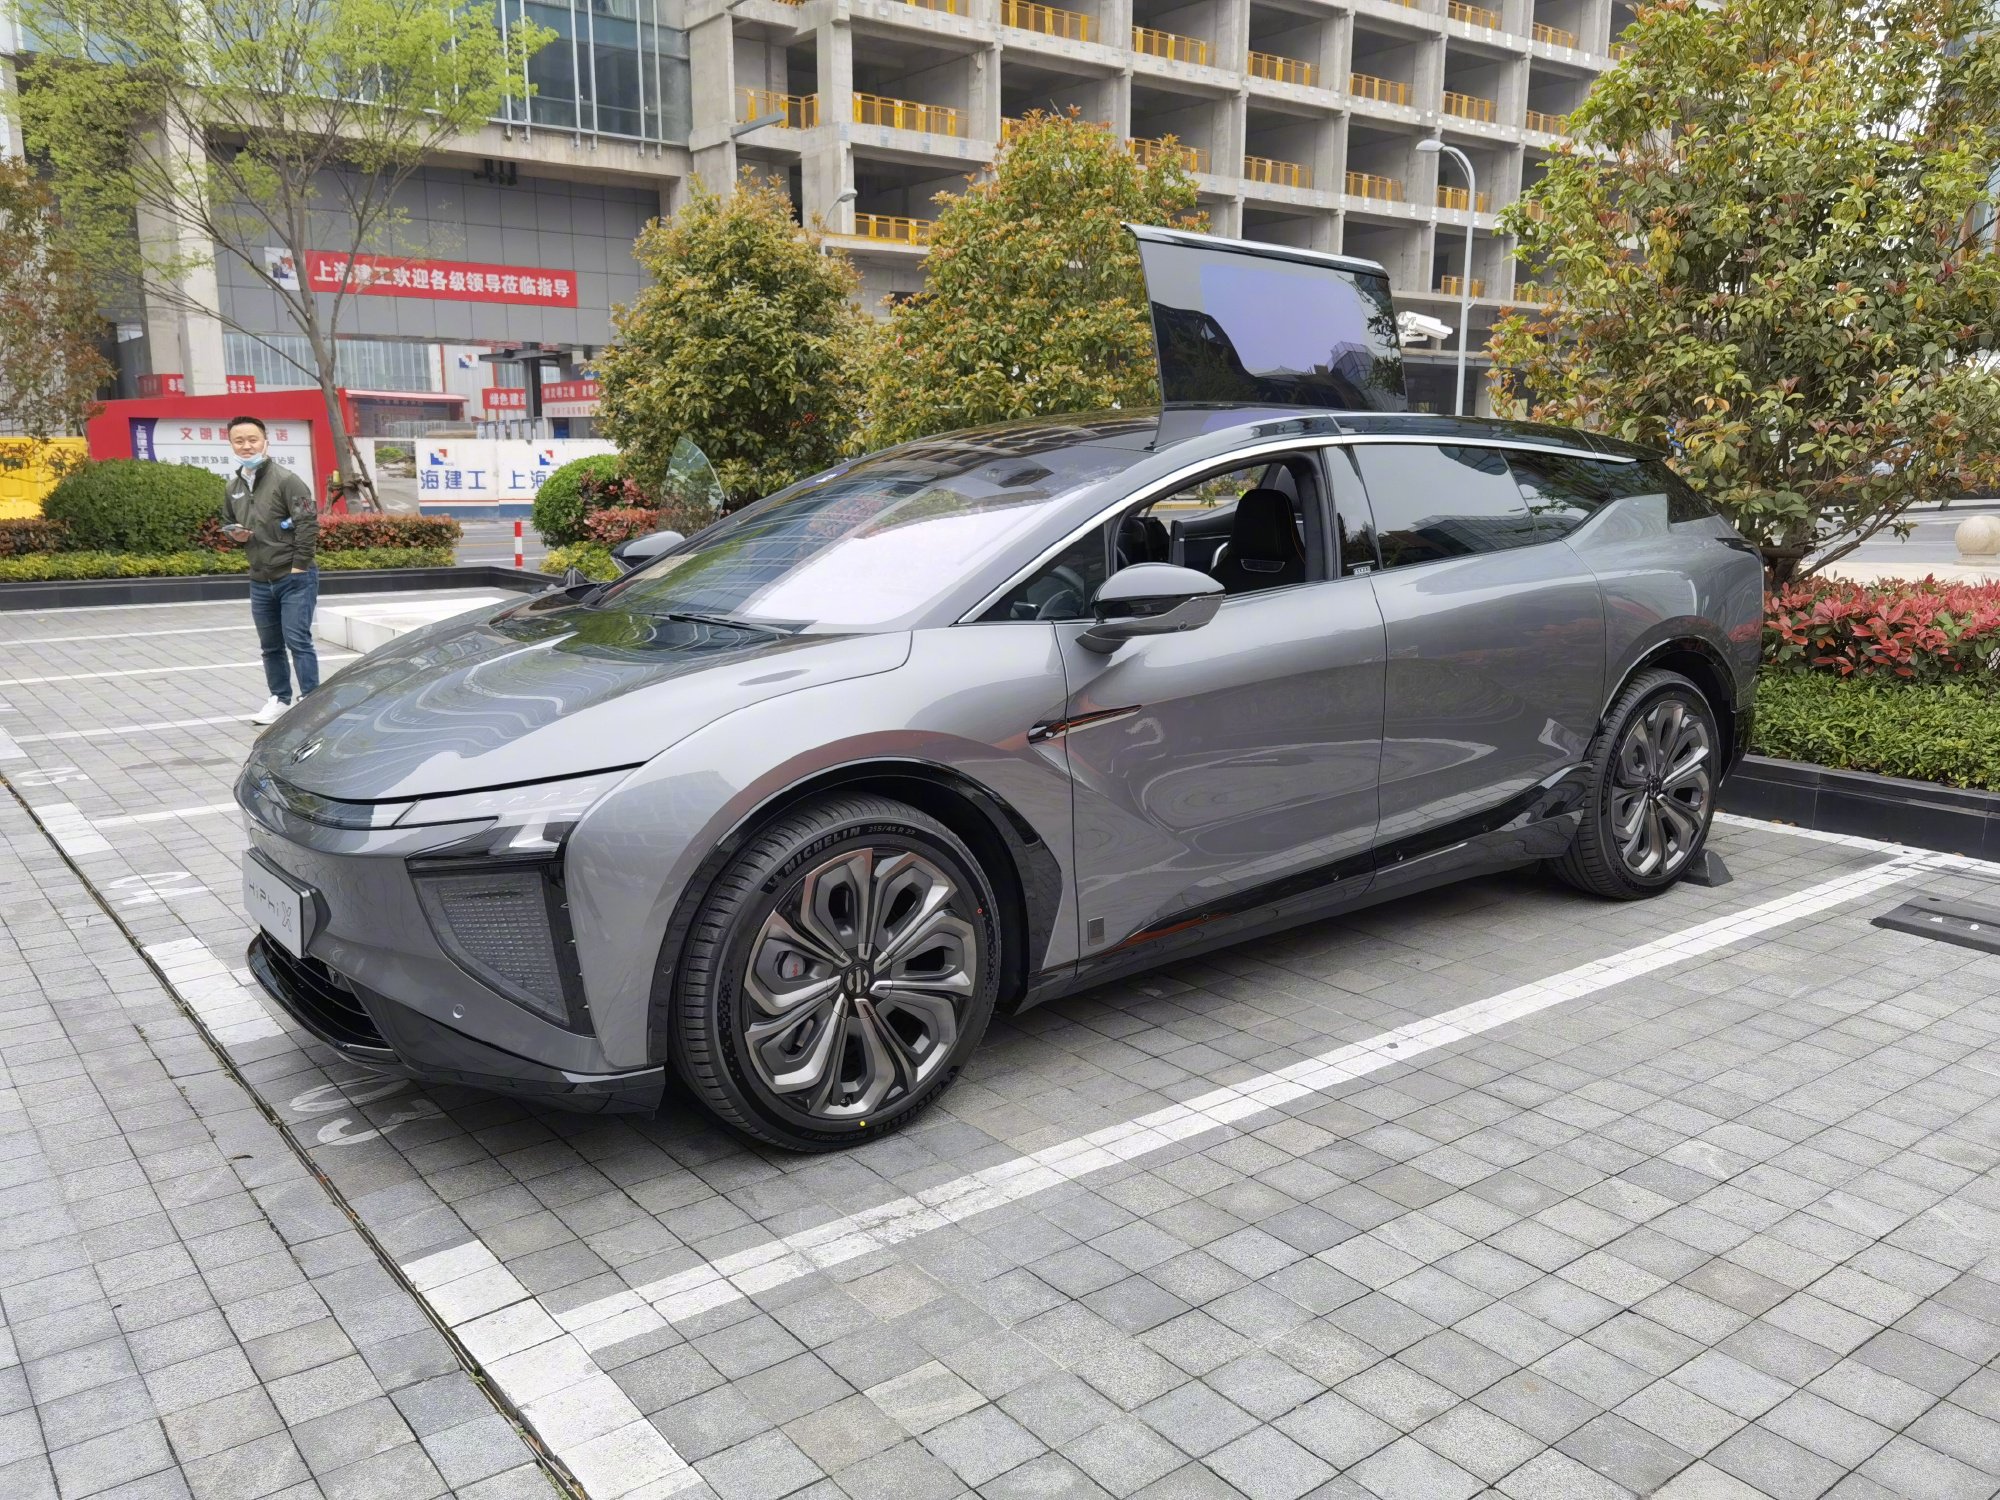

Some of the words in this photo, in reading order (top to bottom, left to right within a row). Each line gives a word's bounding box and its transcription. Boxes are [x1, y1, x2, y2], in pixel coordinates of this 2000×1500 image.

[314, 260, 570, 298] 上海建工欢迎各级领导莅临指导
[420, 469, 487, 490] 海建工
[507, 469, 555, 490] 上海
[784, 826, 861, 875] MICHELIN
